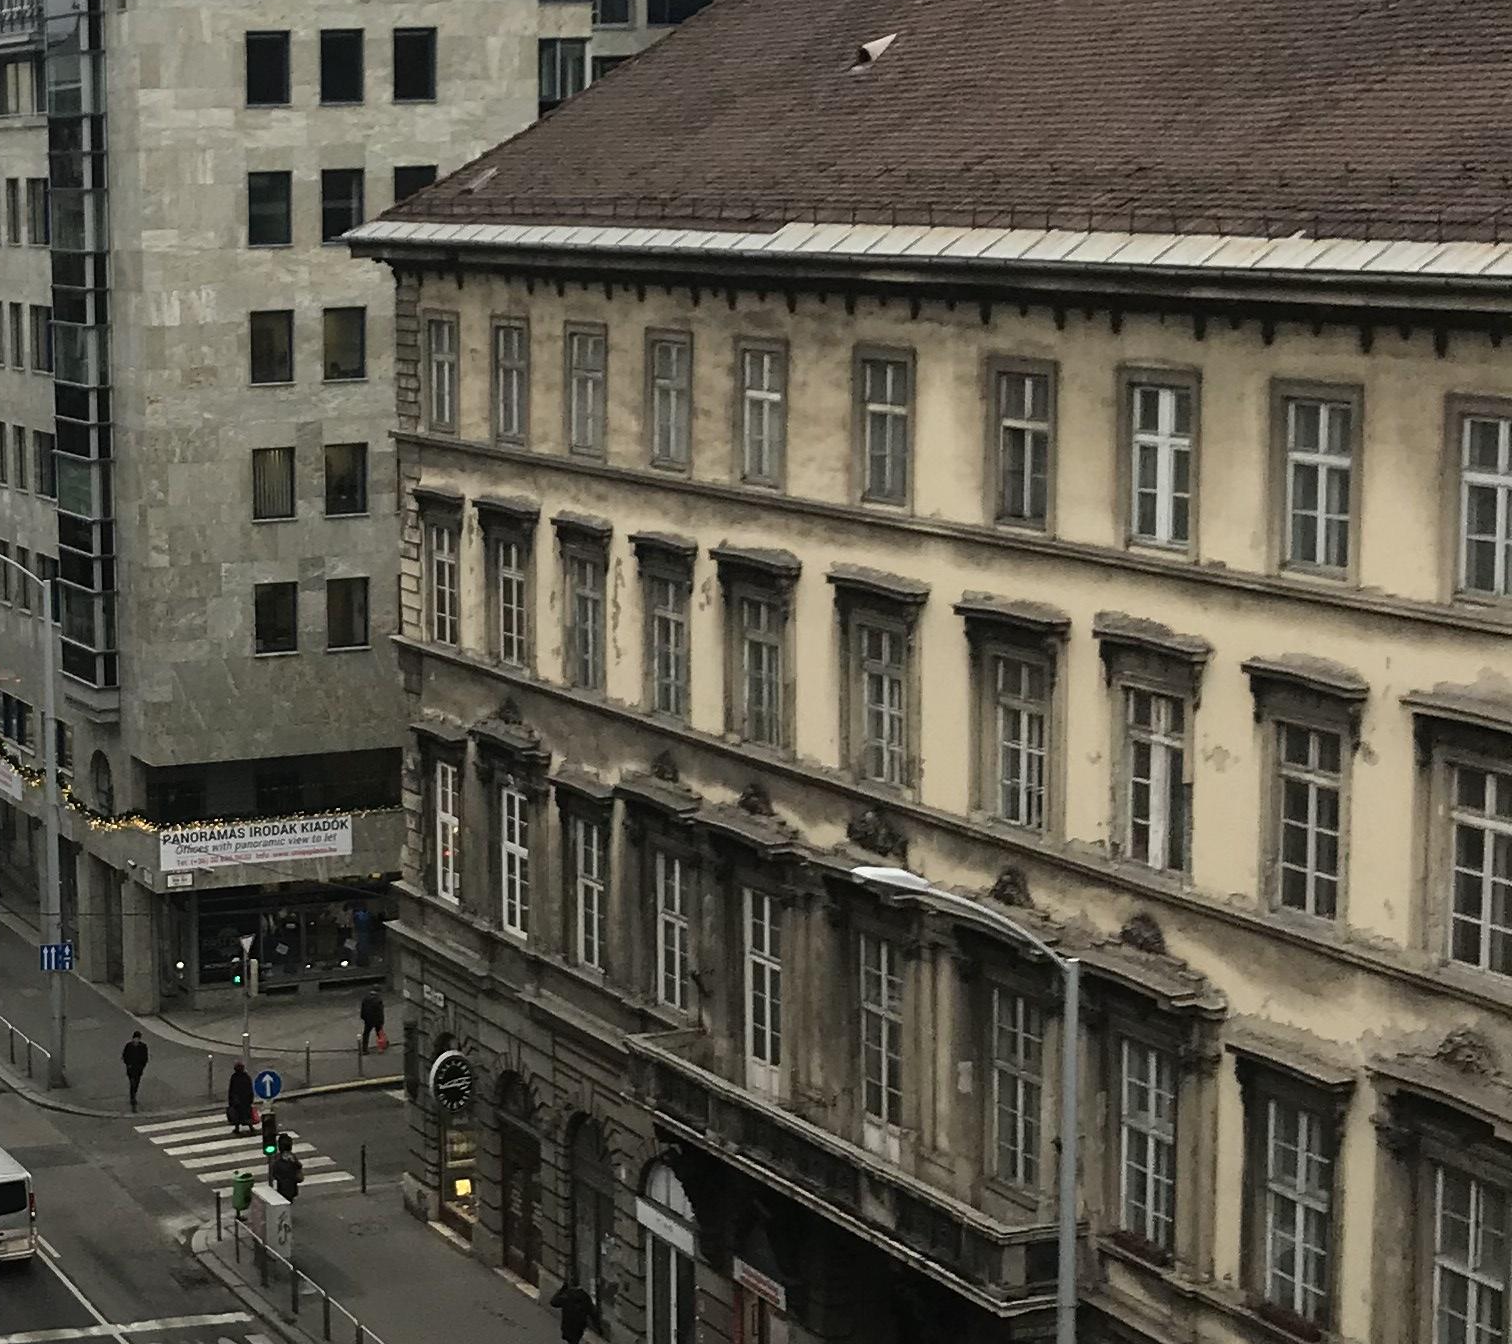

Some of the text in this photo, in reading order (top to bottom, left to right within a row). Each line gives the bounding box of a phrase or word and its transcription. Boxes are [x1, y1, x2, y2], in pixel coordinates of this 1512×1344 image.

[212, 841, 233, 852] with
[235, 837, 286, 852] panoramic
[288, 835, 310, 846] view
[312, 834, 322, 844] to
[324, 831, 337, 842] let
